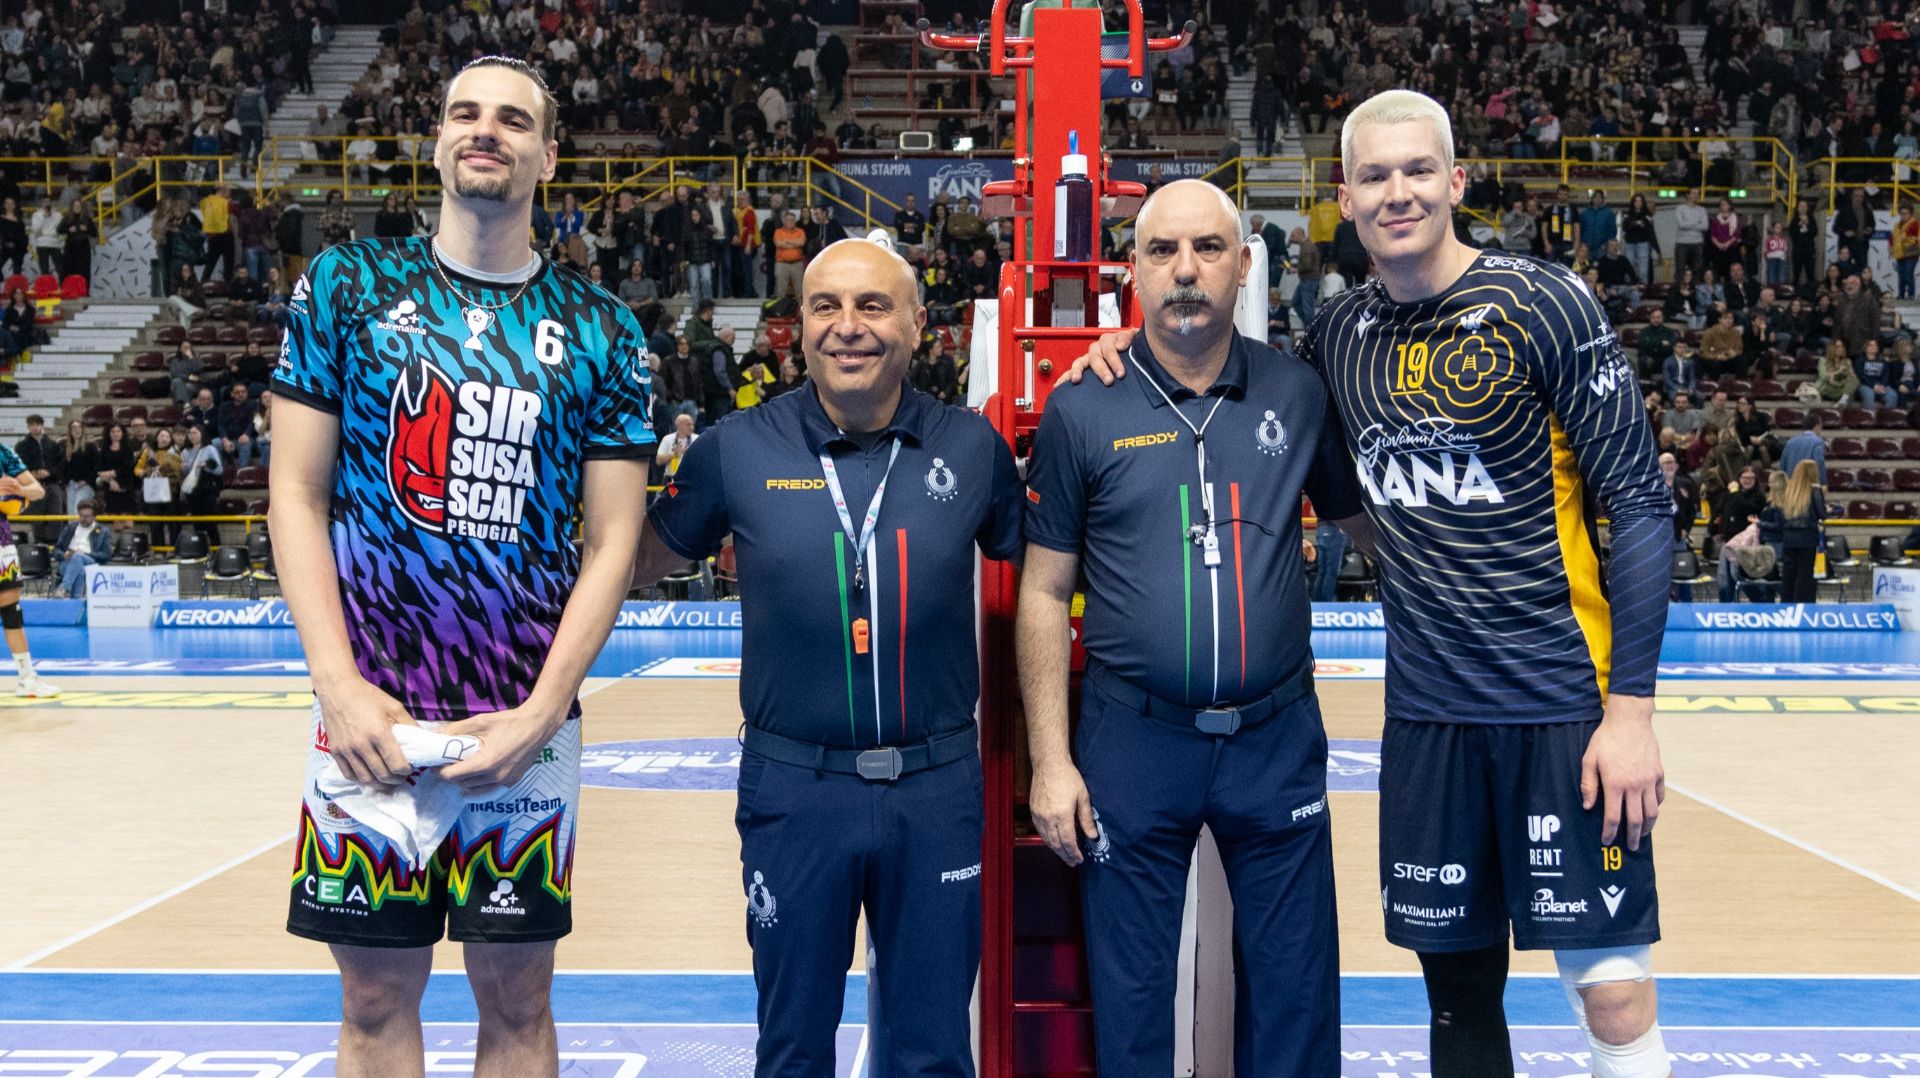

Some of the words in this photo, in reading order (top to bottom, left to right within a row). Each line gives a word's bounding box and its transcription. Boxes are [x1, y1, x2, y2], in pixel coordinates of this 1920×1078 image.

[871, 163, 911, 176] STAMPA
[376, 321, 427, 335] adrenalina
[534, 319, 565, 365] 6
[1396, 342, 1429, 390] 19
[456, 381, 542, 447] SIR
[1113, 431, 1178, 451] FREDDY
[1358, 423, 1427, 468] Giovanni
[450, 437, 535, 488] SUSA
[766, 479, 829, 490] FREDD
[447, 478, 527, 525] SCAI
[447, 518, 519, 543] PERUGIA
[1802, 611, 1896, 628] VOLLEY
[1527, 814, 1561, 842] UP
[1529, 848, 1562, 866] RENT
[1601, 846, 1623, 871] 19
[304, 874, 369, 905] CEA
[301, 899, 325, 911] ENERGY
[330, 907, 369, 917] SYSTEMS
[480, 905, 526, 915] adrenalina
[1393, 902, 1457, 918] MAXIMILIAN
[1458, 906, 1466, 917] I
